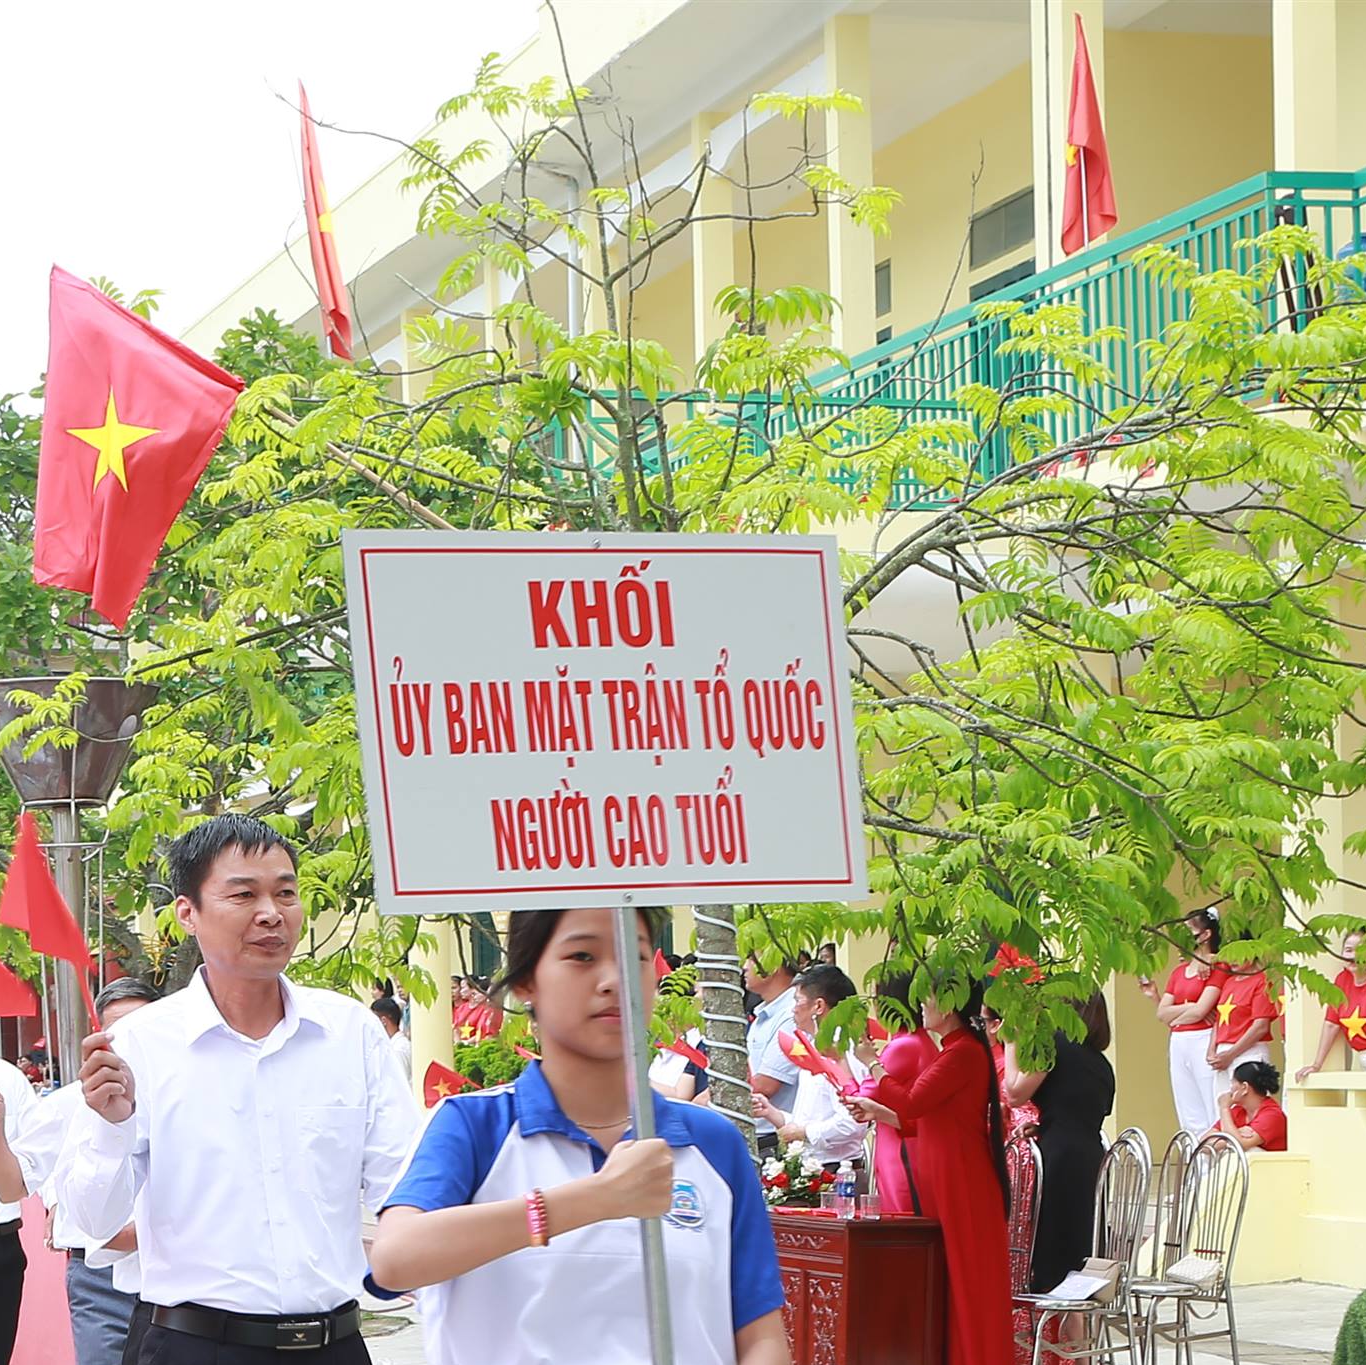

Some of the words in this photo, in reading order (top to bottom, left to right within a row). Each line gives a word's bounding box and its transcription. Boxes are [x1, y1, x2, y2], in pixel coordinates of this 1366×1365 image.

[527, 560, 675, 649] KHỐI
[389, 656, 432, 757] ỦY
[443, 681, 517, 755] BAN
[523, 665, 593, 768] MẶT
[601, 662, 689, 766] TRẬN
[694, 648, 735, 751] TỔ
[743, 659, 825, 759] QUỐC
[490, 778, 596, 871] NGƯỜI
[604, 794, 668, 868] CAO
[675, 765, 748, 865] TUỔI
